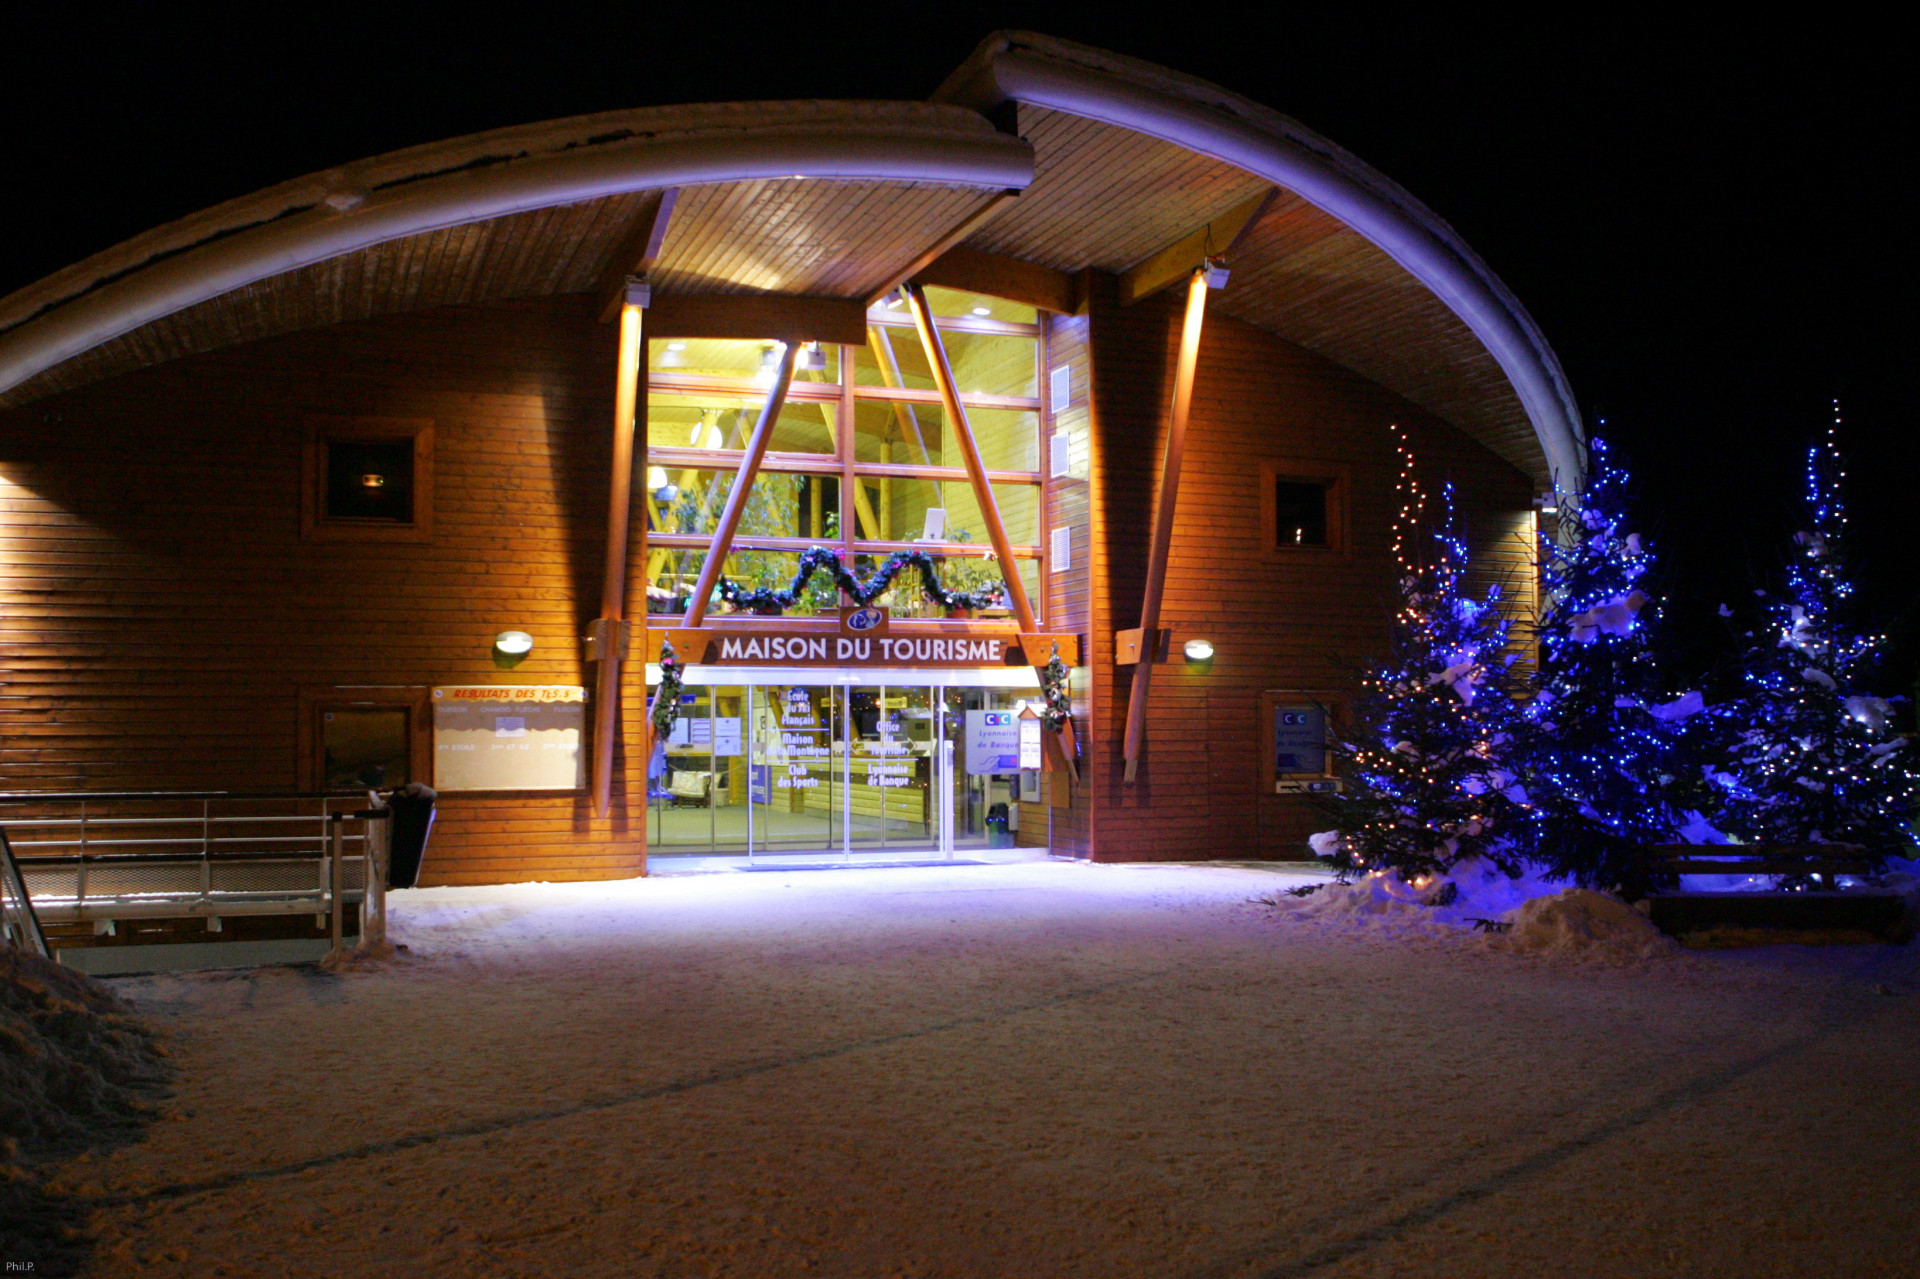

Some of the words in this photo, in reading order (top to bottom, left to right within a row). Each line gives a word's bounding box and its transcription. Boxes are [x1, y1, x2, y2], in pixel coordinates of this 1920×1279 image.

[721, 637, 826, 660] MAISON
[836, 638, 870, 661] DU
[879, 638, 1001, 661] TOURISME
[454, 689, 510, 699] RESULTATS
[515, 689, 536, 699] DES
[541, 690, 569, 699] TESS
[986, 714, 1010, 725] CIC
[782, 733, 814, 745] Maison
[979, 730, 1017, 738] Lyonnaise
[788, 765, 808, 776] Club
[867, 763, 909, 775] Lyonnaise
[793, 776, 819, 789] Sports
[867, 776, 878, 786] de
[878, 775, 909, 788] Banque
